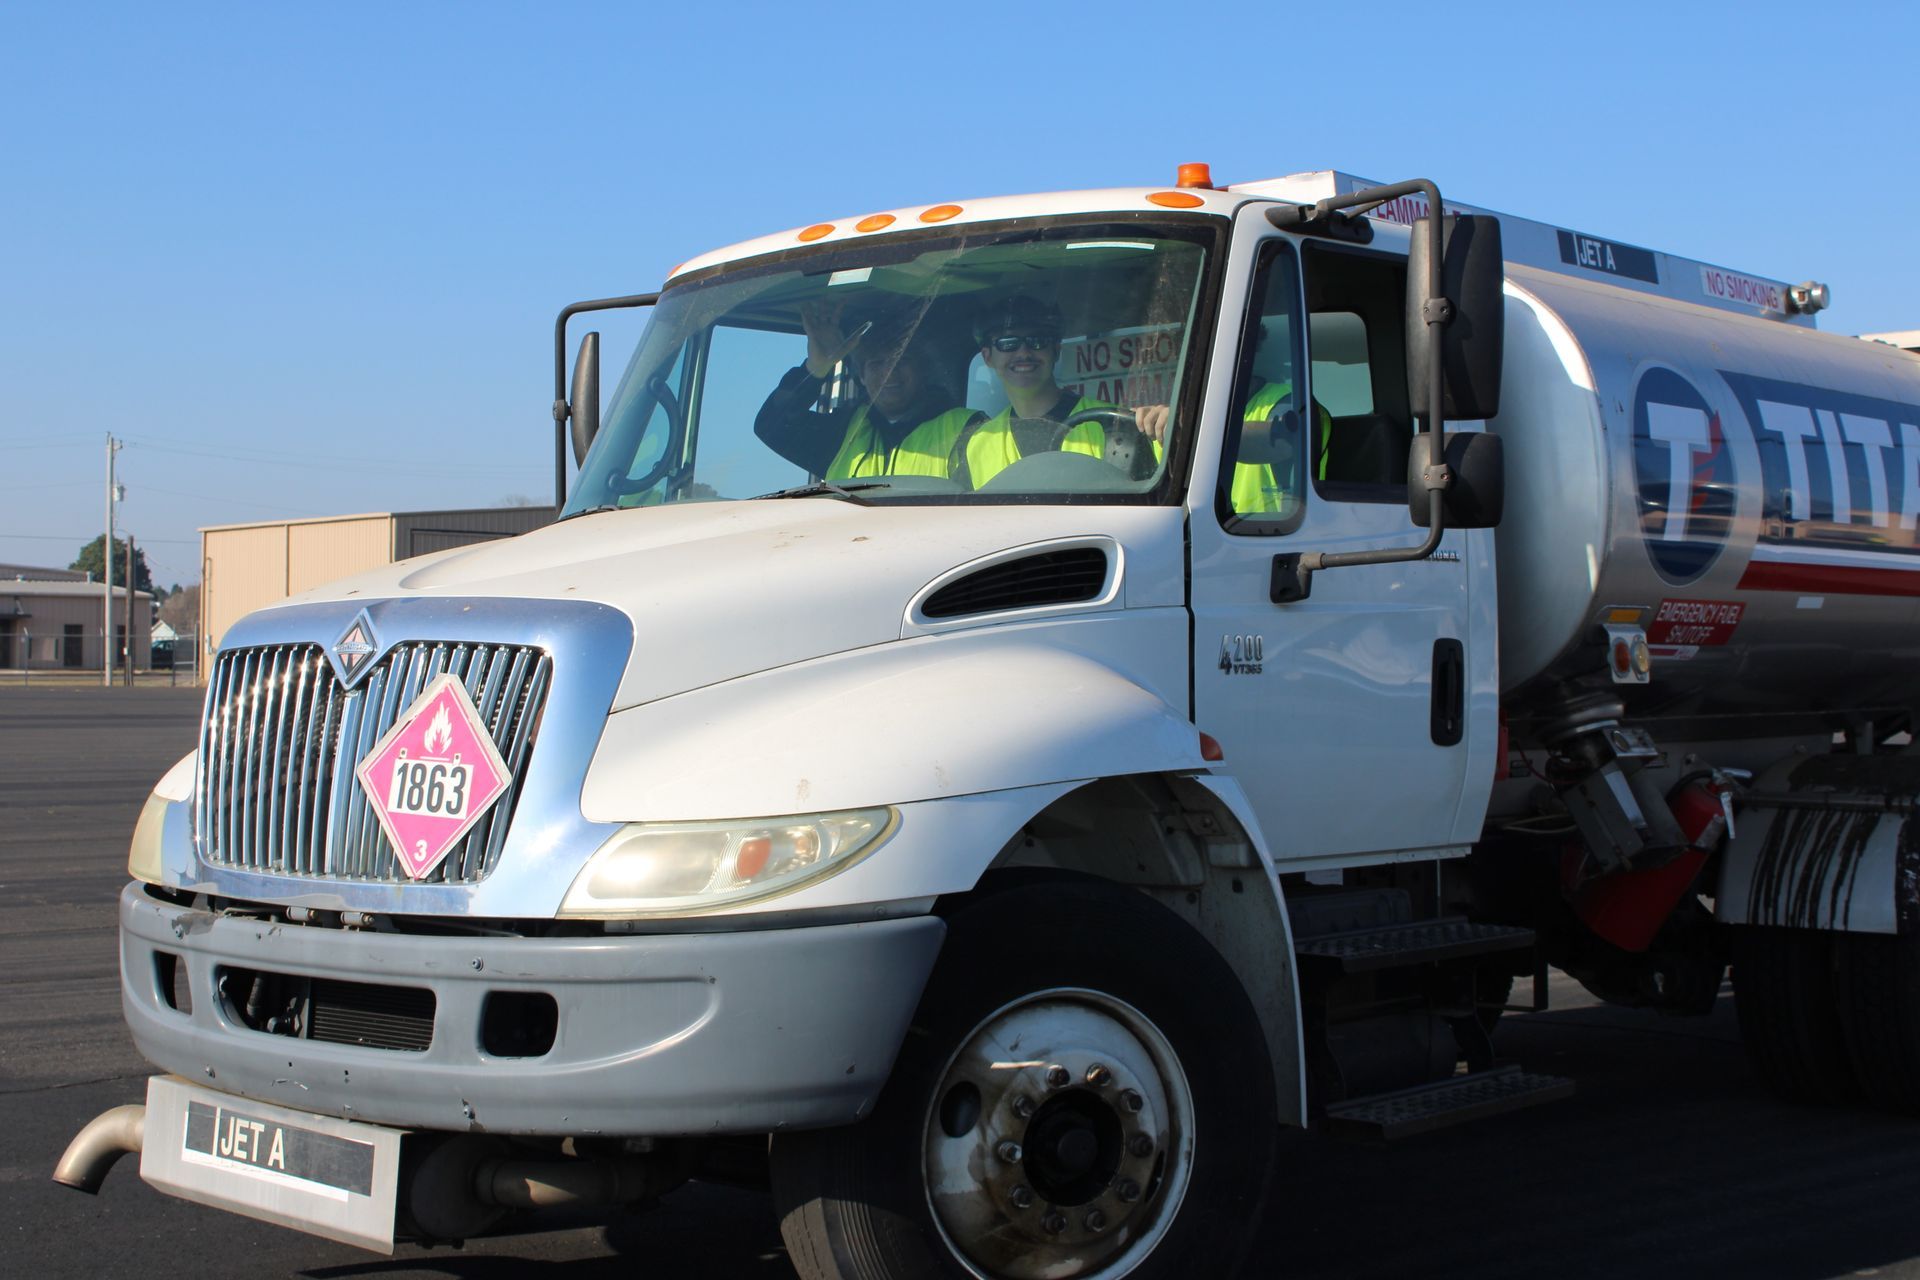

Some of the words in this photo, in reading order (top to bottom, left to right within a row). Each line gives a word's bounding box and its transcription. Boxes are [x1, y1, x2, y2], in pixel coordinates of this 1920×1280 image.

[1580, 238, 1602, 267] JET
[1605, 244, 1617, 271] A
[1706, 271, 1725, 296] NO
[1726, 275, 1779, 309] SMOKING
[1076, 341, 1111, 373] NO
[1118, 333, 1181, 368] SMO
[1656, 602, 1720, 623] EMERGENCY
[1665, 625, 1715, 643] SHUTOFF
[1218, 634, 1263, 675] 4200
[396, 762, 467, 815] 1863
[414, 839, 428, 862] 3
[220, 1116, 265, 1163] JET
[267, 1127, 285, 1170] A
